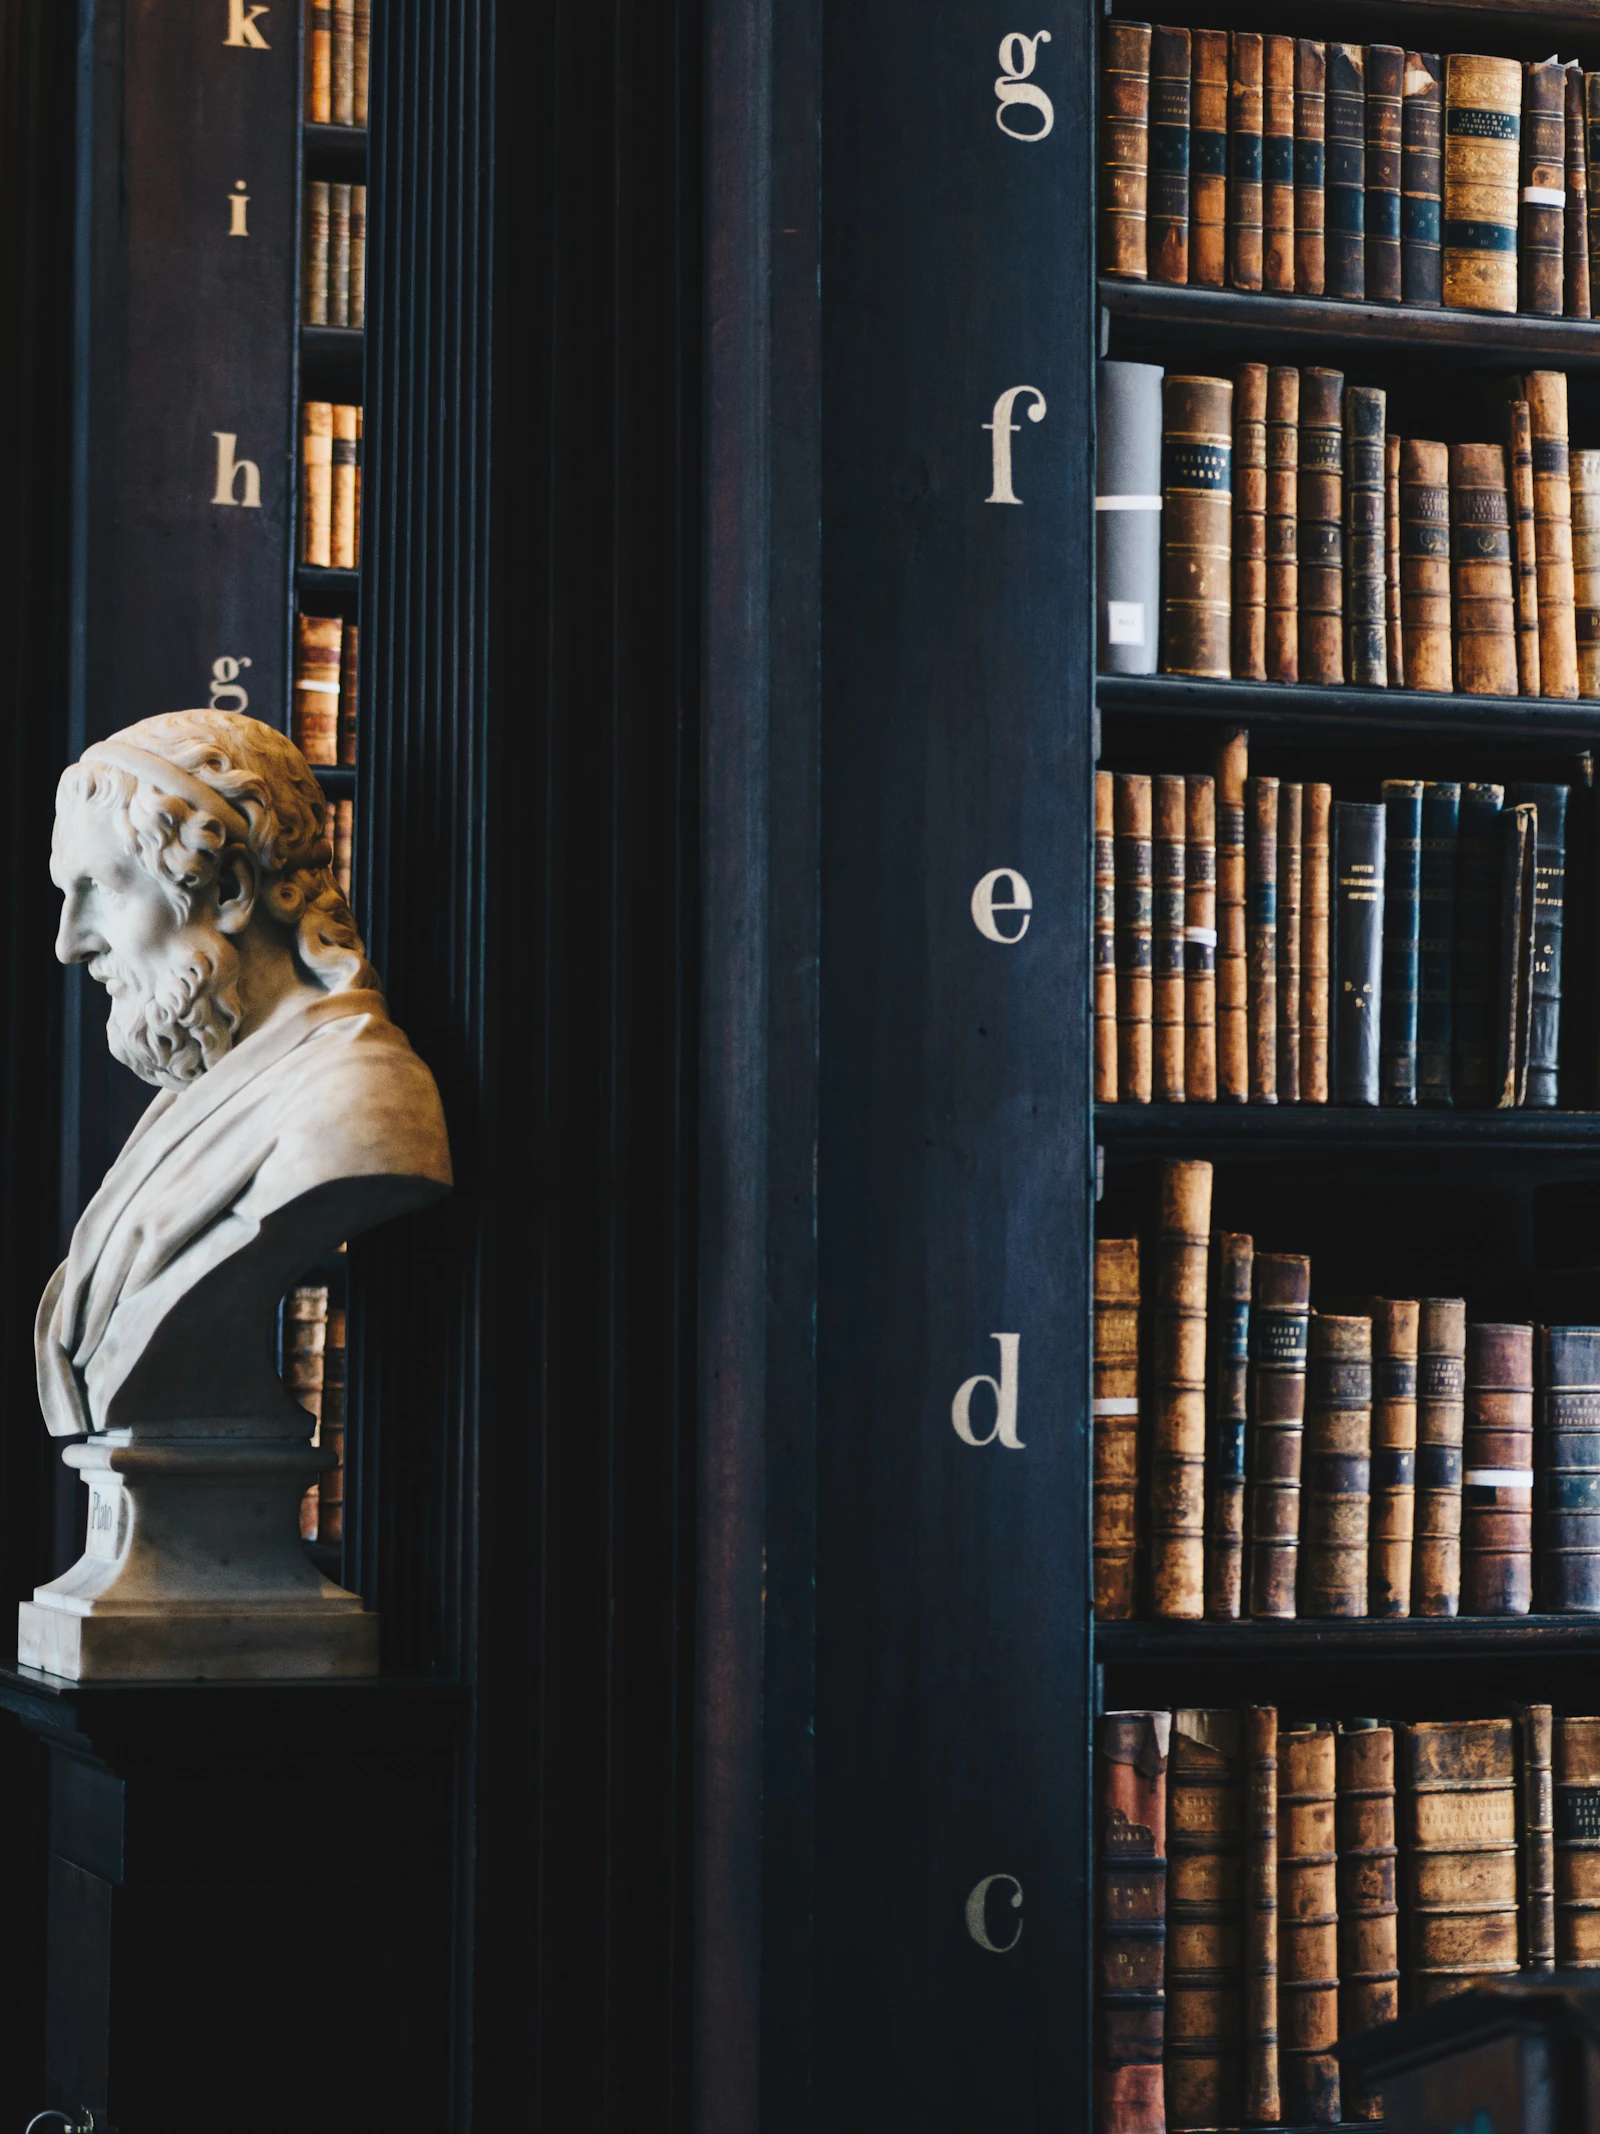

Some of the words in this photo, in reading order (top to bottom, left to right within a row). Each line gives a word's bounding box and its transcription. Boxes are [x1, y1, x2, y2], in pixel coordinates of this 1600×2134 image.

[223, 0, 272, 50] k
[994, 29, 1055, 143] g
[228, 180, 250, 237] i
[211, 431, 262, 508] h
[981, 385, 1047, 505] f
[208, 656, 252, 713] g
[971, 867, 1033, 944] e
[951, 1332, 1026, 1449] d
[92, 1491, 112, 1531] Plato
[965, 1873, 1024, 1953] c
